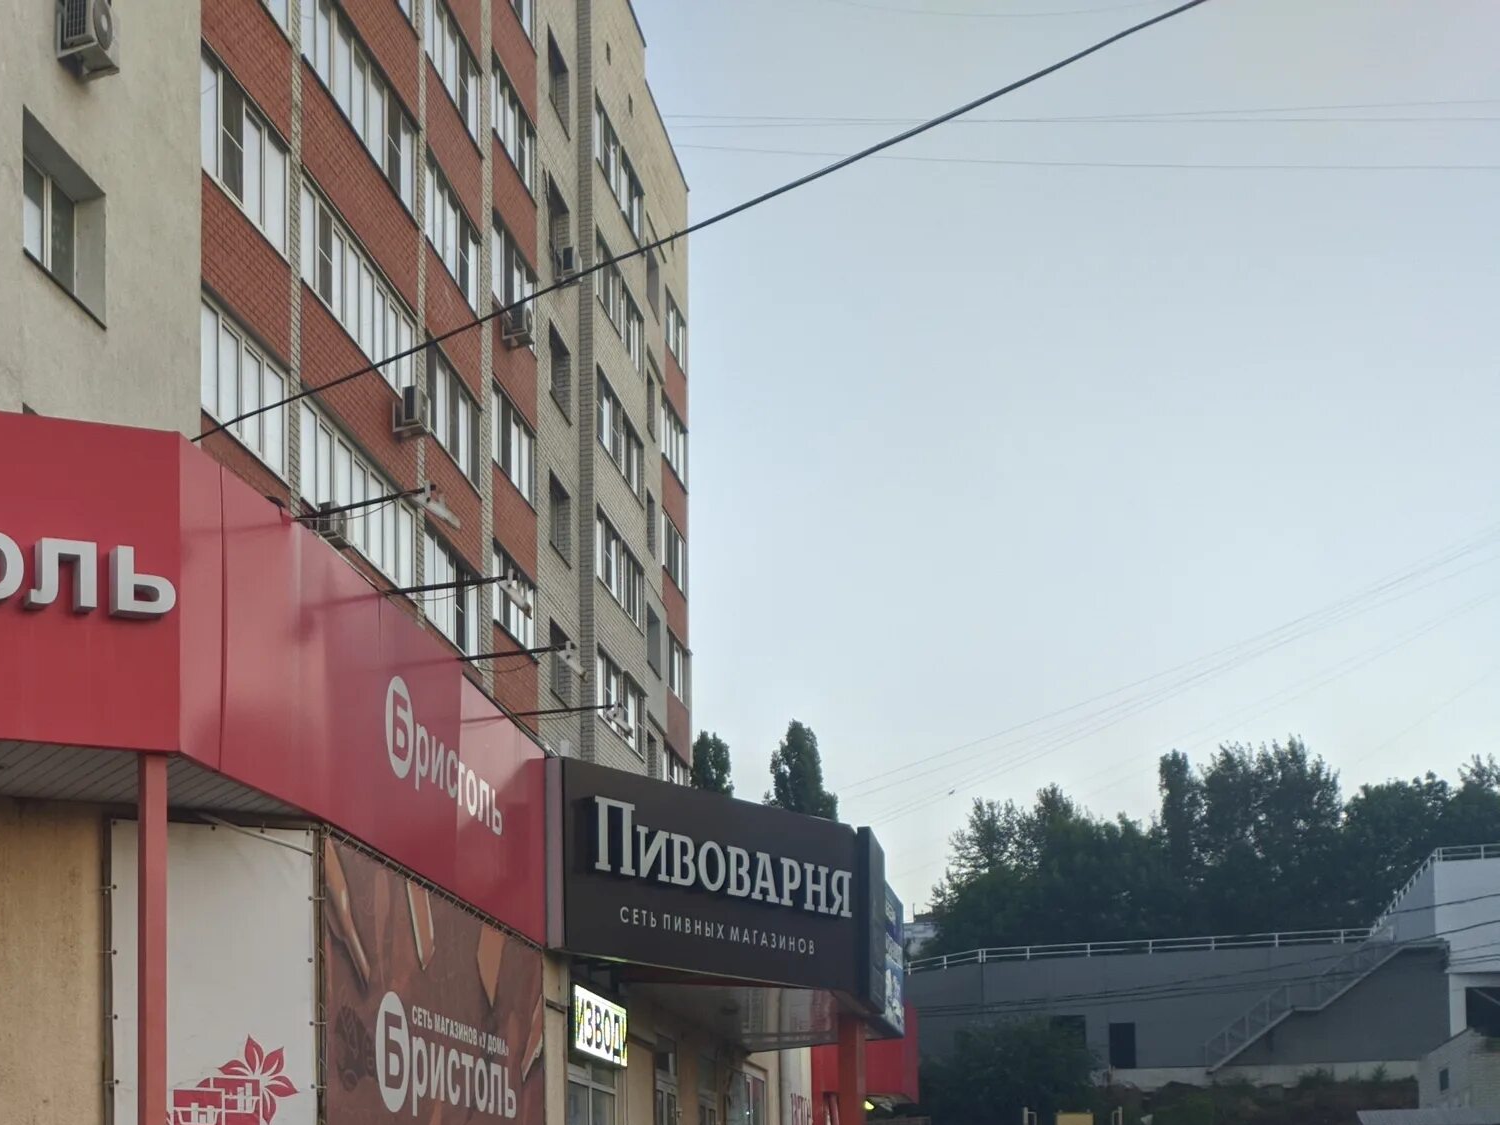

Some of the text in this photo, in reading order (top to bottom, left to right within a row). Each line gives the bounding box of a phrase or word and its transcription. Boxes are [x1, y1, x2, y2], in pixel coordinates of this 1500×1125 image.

[386, 676, 502, 836] Бристоль
[620, 905, 815, 955] СЕТЬ ПИВНЫХ МАГАЗИНОВ
[375, 991, 517, 1118] Бристоль
[412, 1005, 433, 1030] СЕТЬ
[434, 1013, 478, 1047] МАГАЗИНОВ
